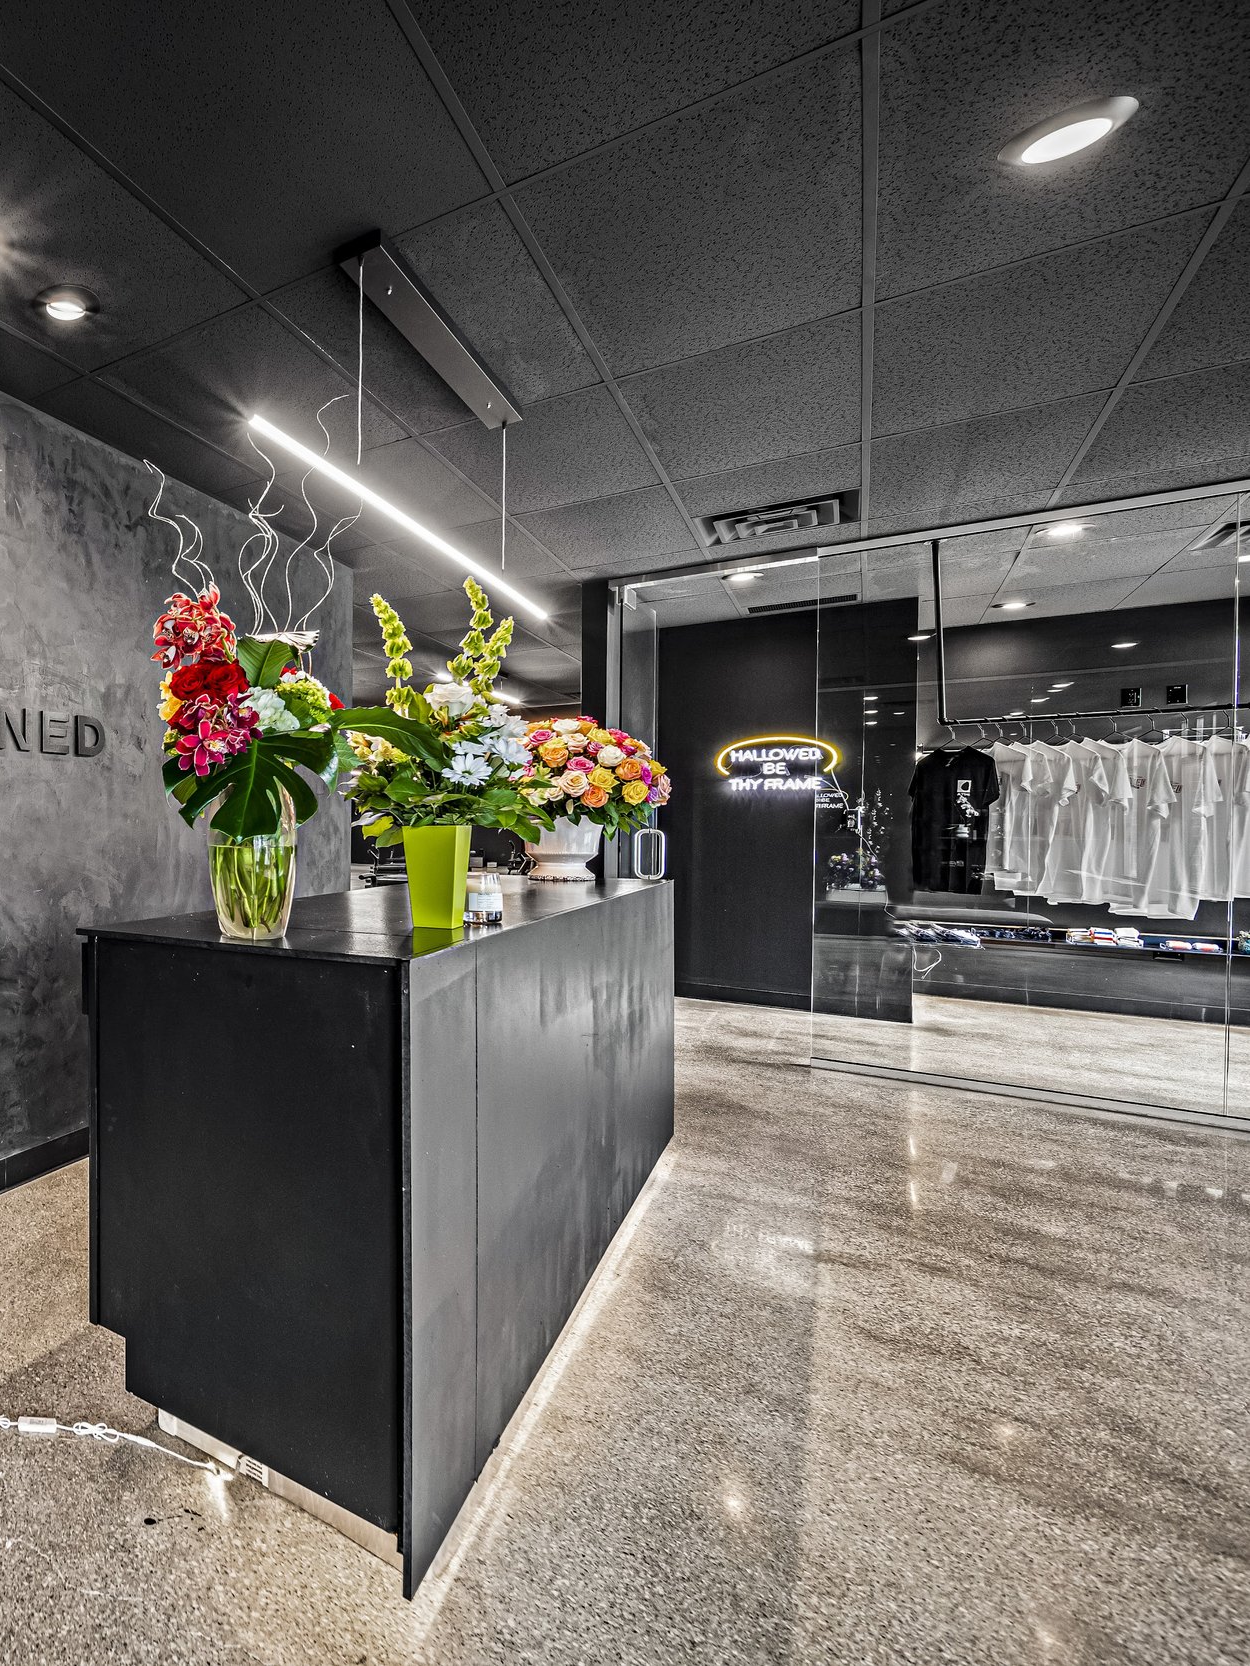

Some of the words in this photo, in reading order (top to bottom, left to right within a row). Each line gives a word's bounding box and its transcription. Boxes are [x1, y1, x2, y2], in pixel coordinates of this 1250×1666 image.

[730, 747, 822, 762] HALLOWED
[762, 762, 787, 775] BE
[729, 777, 763, 791] THY
[763, 776, 823, 791] FRAME
